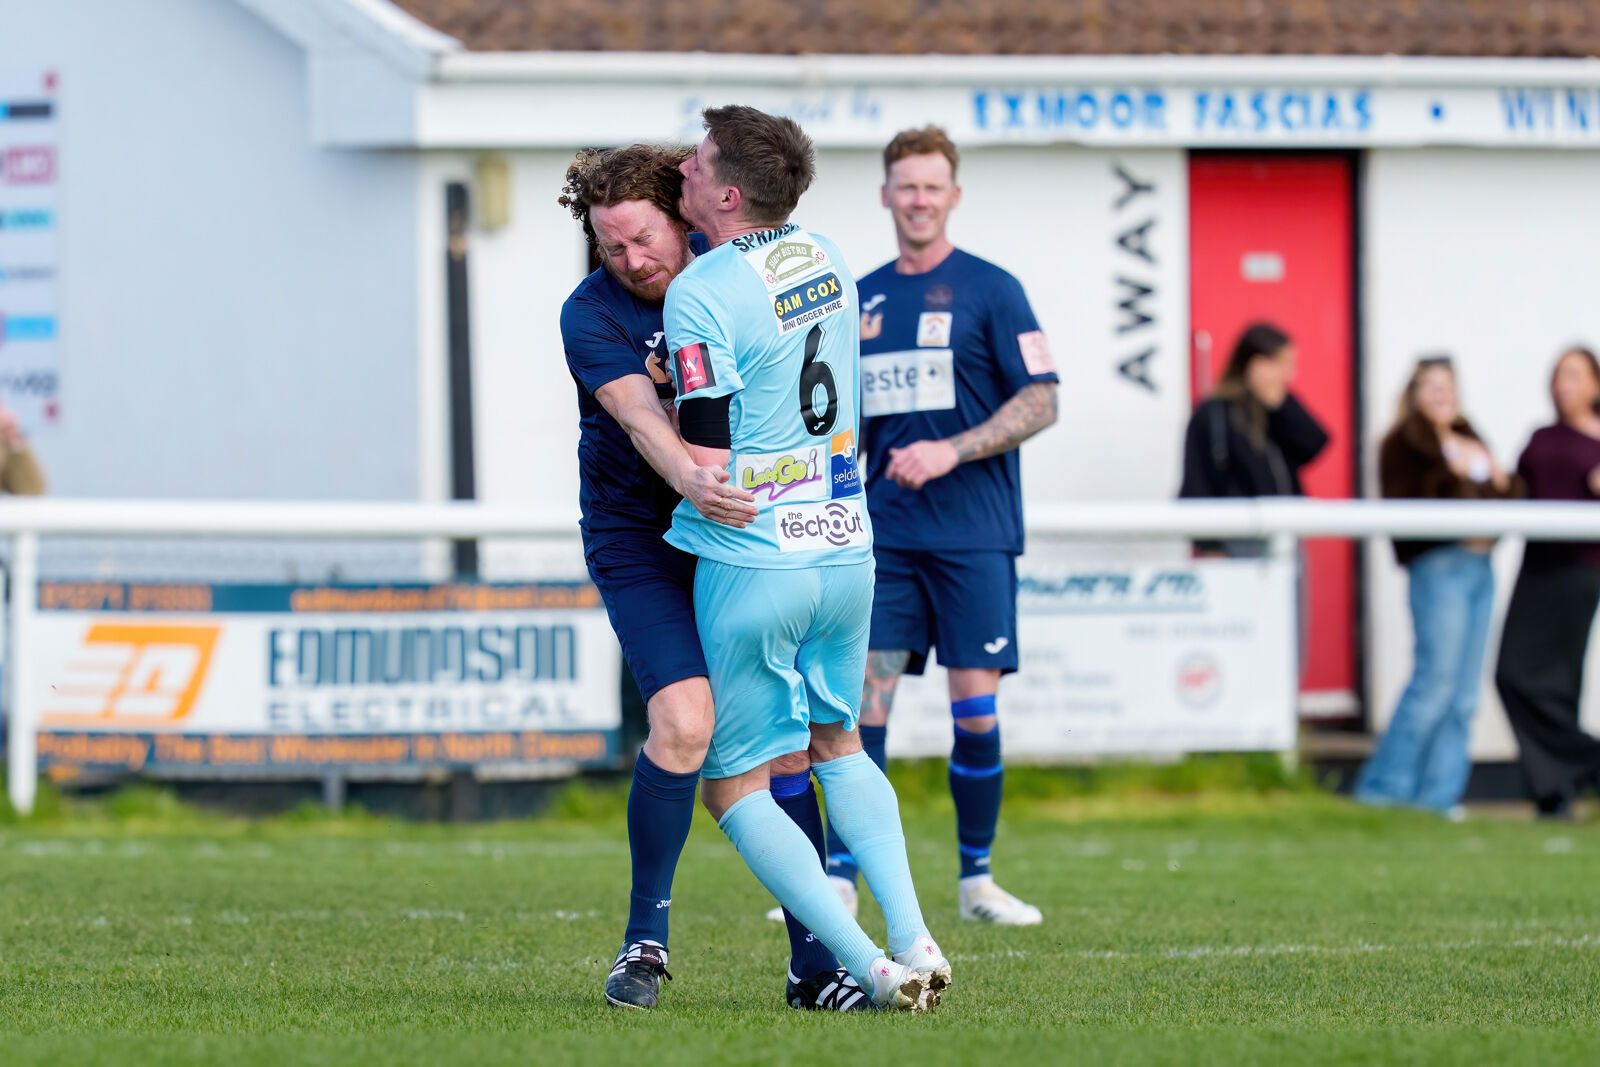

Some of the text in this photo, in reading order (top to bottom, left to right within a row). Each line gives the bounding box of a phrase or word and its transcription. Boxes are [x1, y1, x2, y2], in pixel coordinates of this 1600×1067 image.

[972, 86, 1600, 132] EXMOOR FASCIAS WIN
[781, 245, 807, 258] BISTRO
[775, 278, 839, 316] SAM COX
[1113, 162, 1160, 394] AWAY
[782, 300, 843, 332] MINI DIGGER HIRE
[799, 322, 840, 436] 6
[788, 512, 803, 520] the
[269, 626, 578, 688] EDMUNDSON
[267, 699, 581, 726] ELECTRICAL
